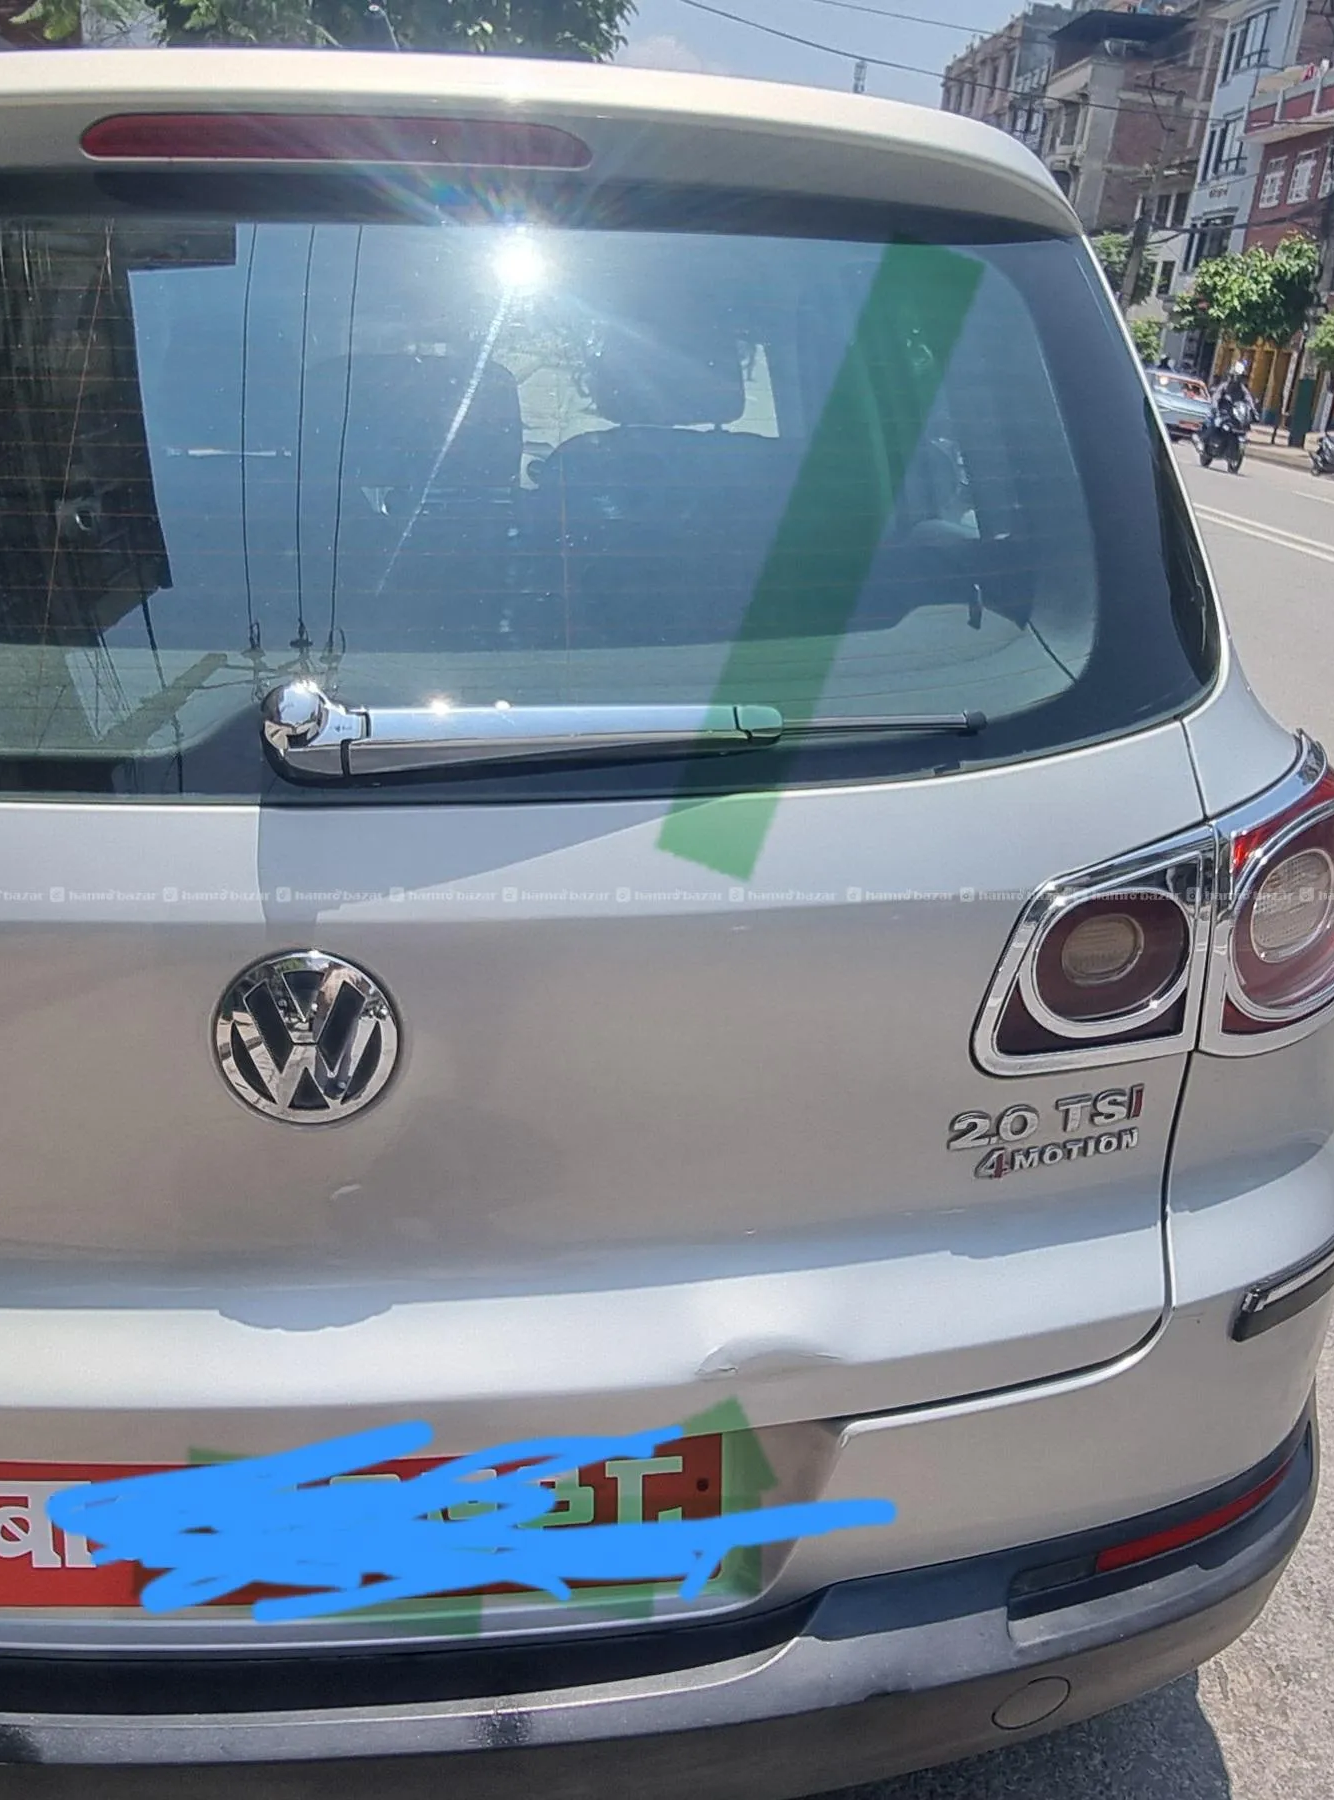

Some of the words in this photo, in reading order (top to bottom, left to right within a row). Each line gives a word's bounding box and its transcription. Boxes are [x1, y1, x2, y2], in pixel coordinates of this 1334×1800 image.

[947, 1104, 1041, 1150] 2.0
[1055, 1083, 1145, 1133] TSI
[974, 1126, 1139, 1179] 4MOTION
